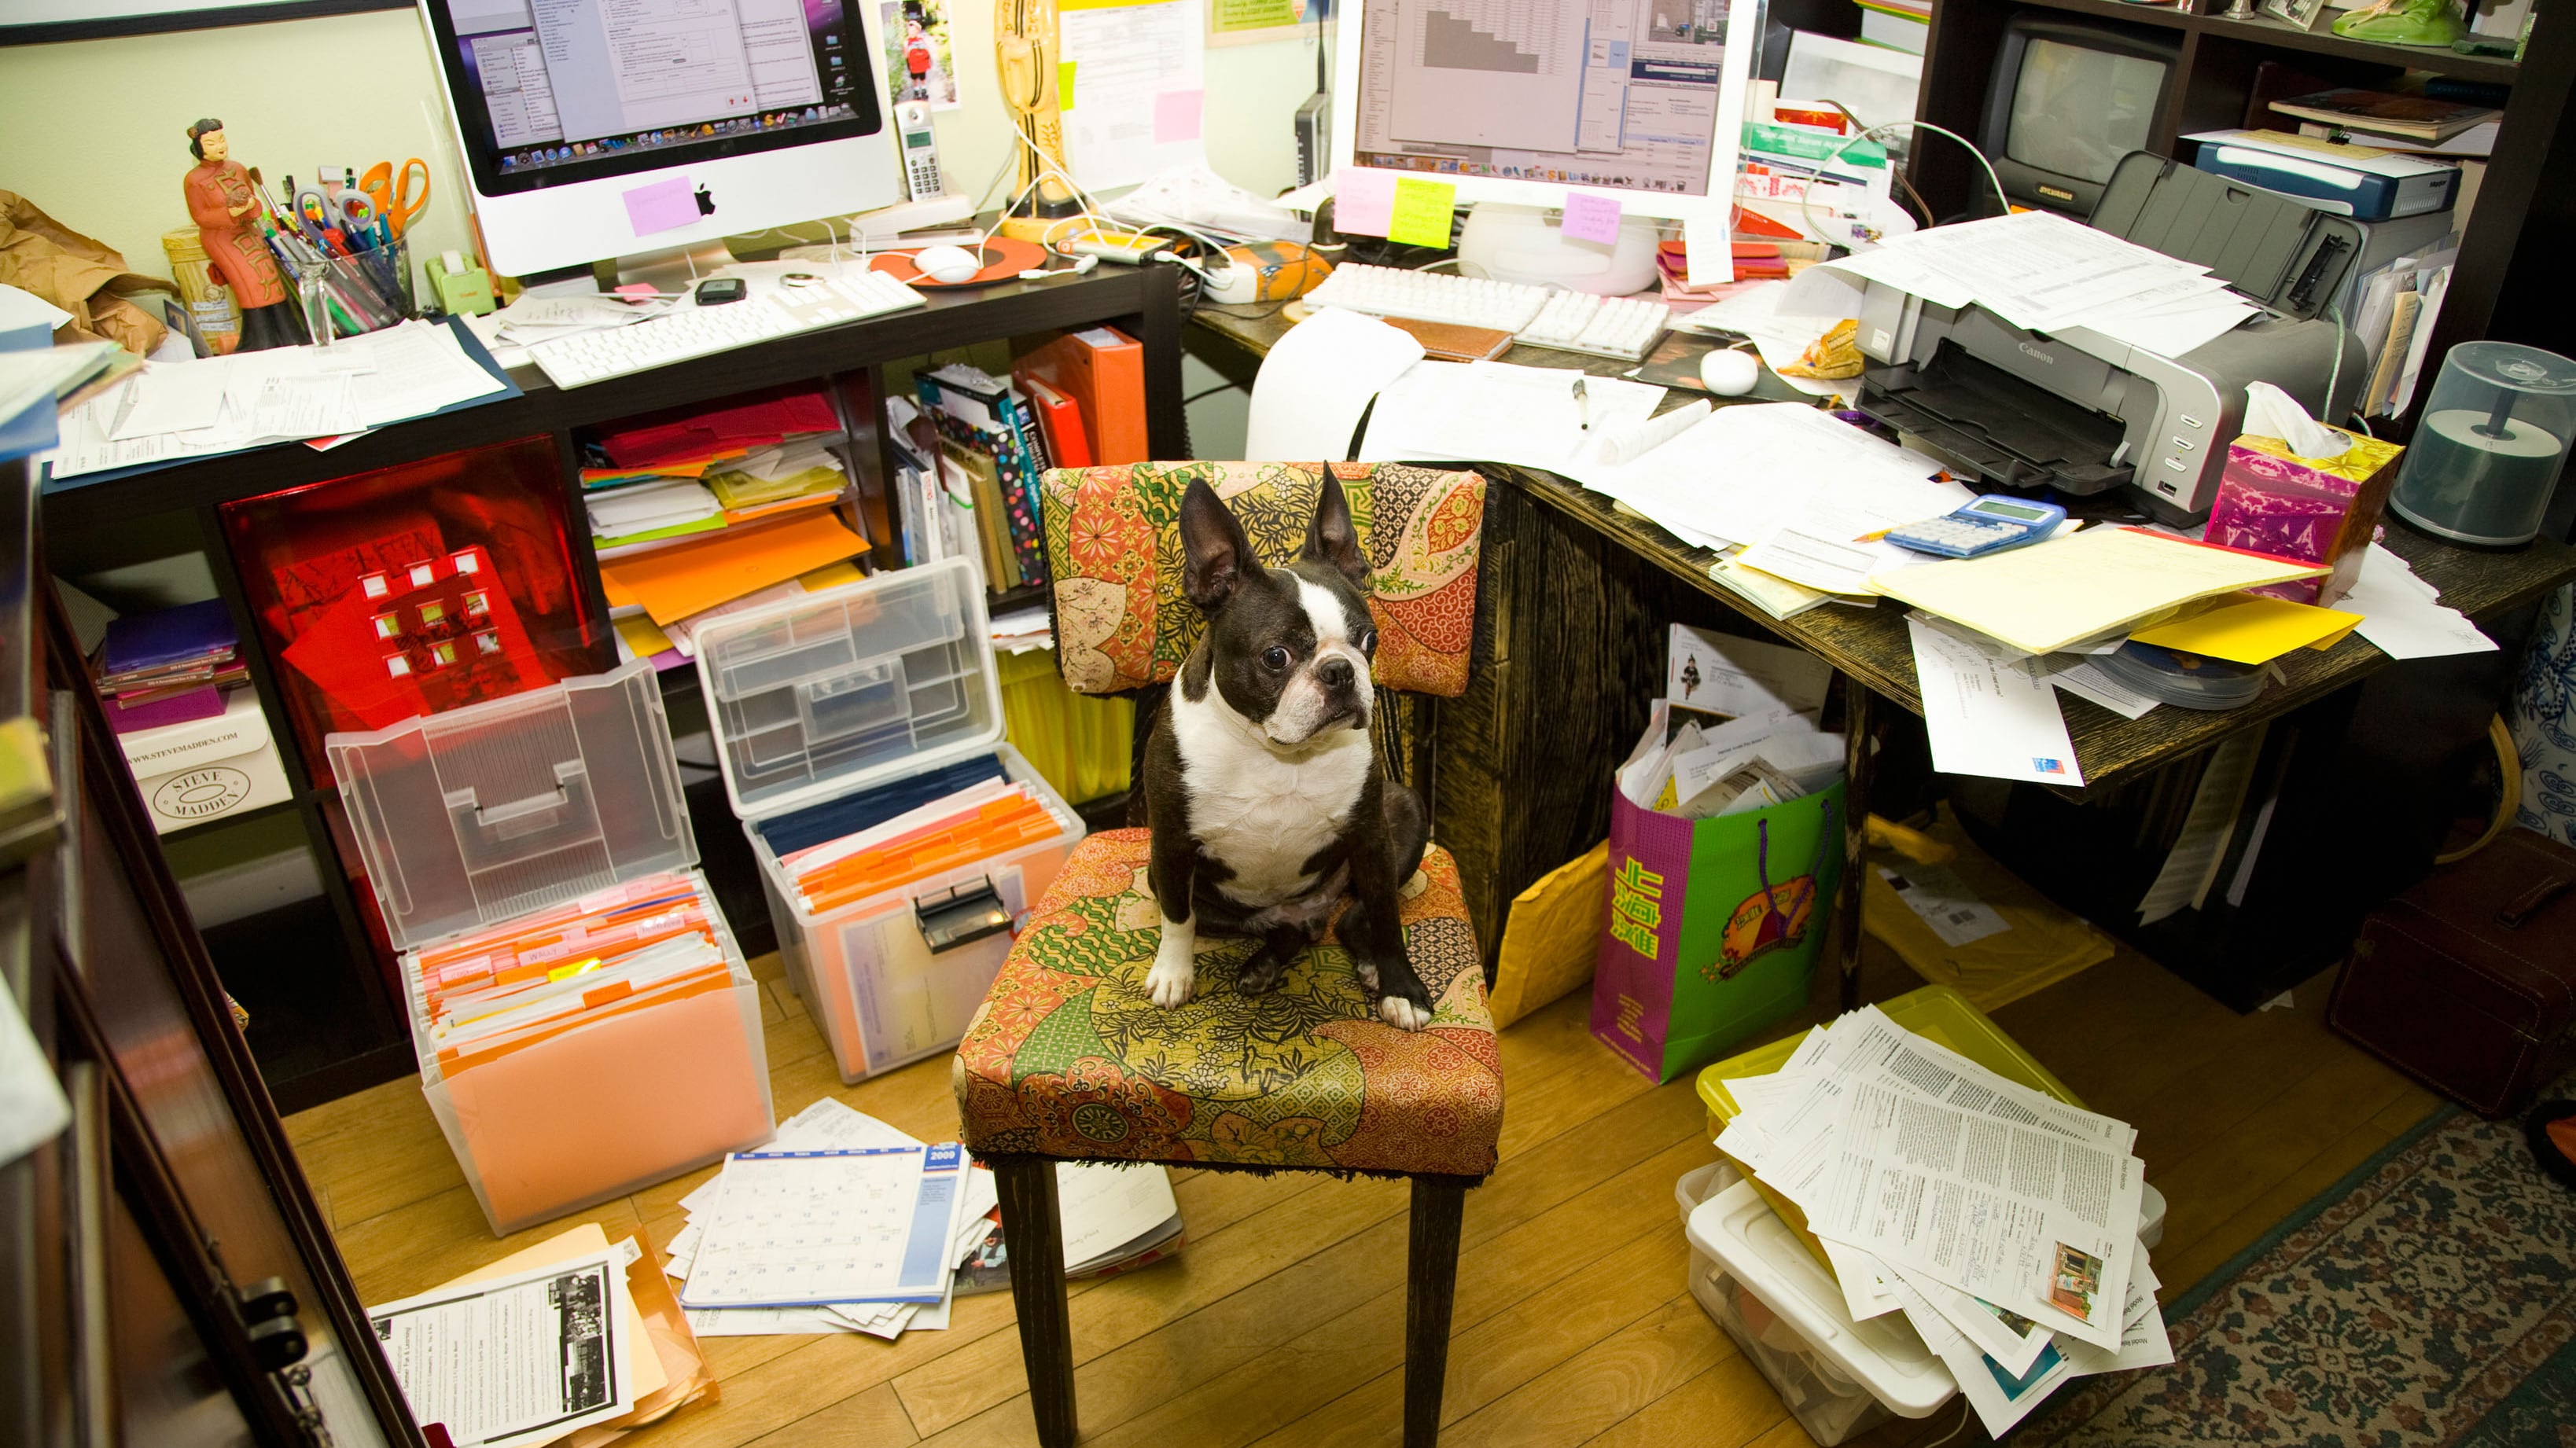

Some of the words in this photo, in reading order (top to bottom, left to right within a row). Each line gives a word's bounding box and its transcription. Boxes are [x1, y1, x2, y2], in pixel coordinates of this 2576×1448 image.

[2018, 342, 2054, 366] Canon
[172, 770, 223, 793] STEVE
[174, 792, 241, 816] MADDEN
[930, 1151, 956, 1161] 2009
[2129, 1295, 2144, 1310] Model
[2131, 1336, 2147, 1347] Model
